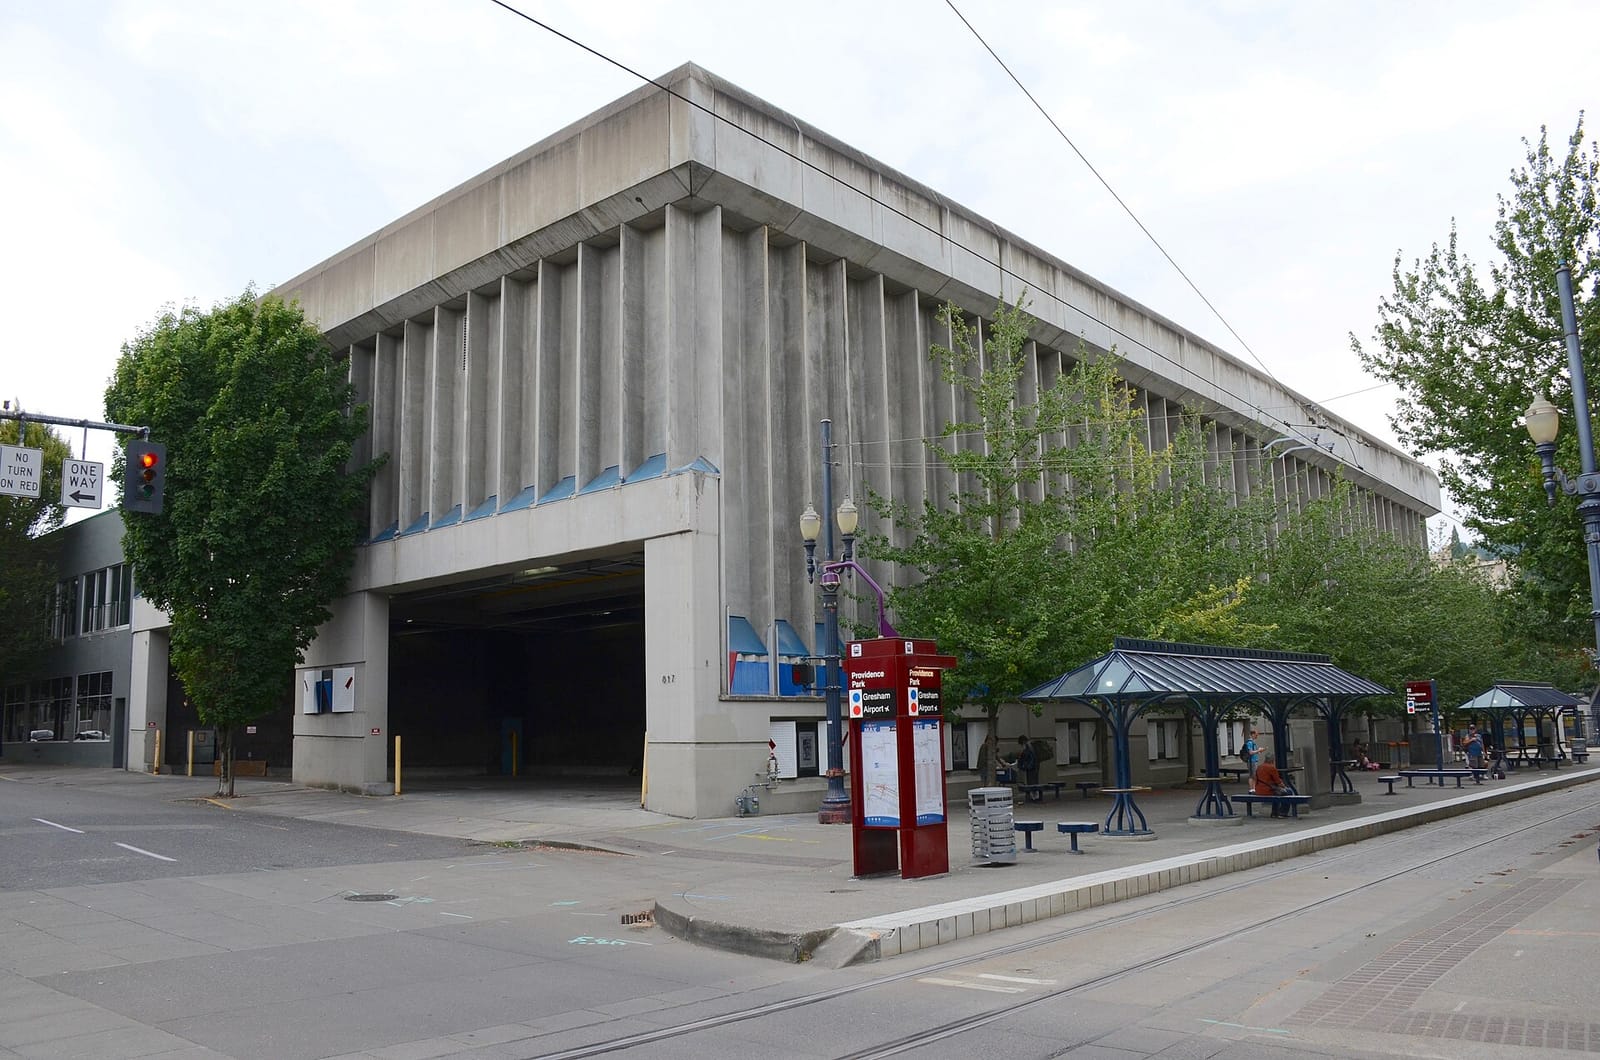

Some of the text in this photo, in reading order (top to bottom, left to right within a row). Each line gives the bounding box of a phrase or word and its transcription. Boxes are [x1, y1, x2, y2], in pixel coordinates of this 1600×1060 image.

[15, 453, 29, 463] NO
[8, 465, 33, 477] TURN
[71, 464, 96, 476] ONE
[0, 478, 38, 491] ON RED
[69, 476, 97, 489] WAY
[851, 671, 885, 680] Providence
[909, 669, 934, 678] Providence
[851, 680, 866, 688] Park
[862, 692, 891, 701] Gresham
[863, 705, 884, 714] Airport
[919, 704, 934, 713] Airport
